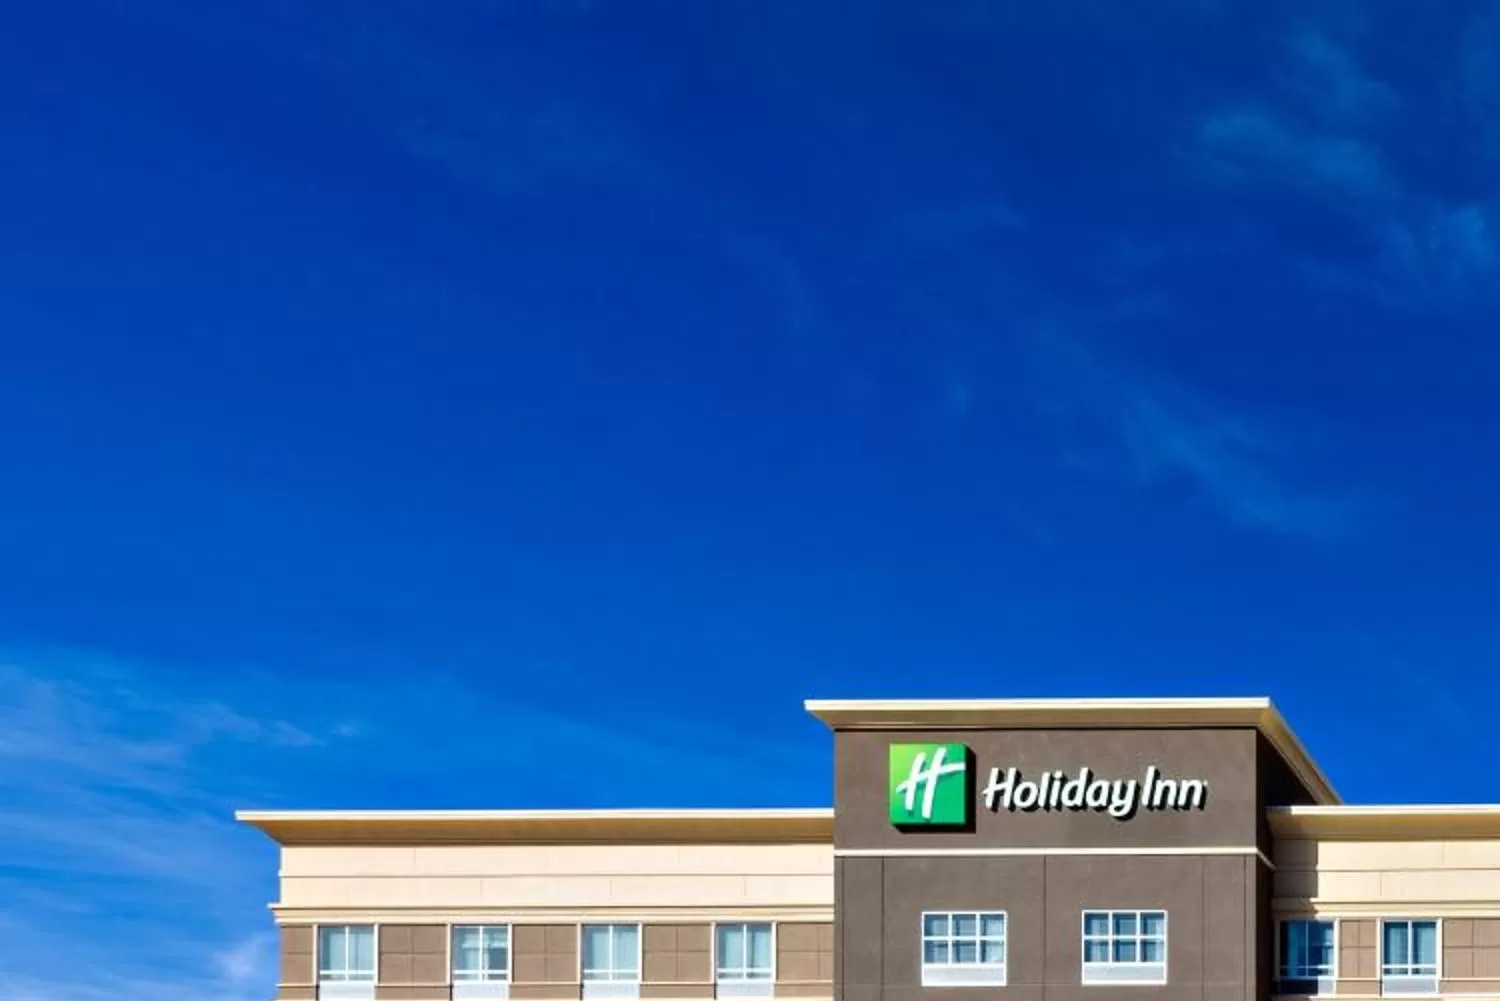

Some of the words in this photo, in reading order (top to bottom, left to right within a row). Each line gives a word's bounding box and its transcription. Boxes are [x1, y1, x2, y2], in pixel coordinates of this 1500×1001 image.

[897, 748, 965, 818] H
[982, 767, 1135, 818] Holiday
[1141, 766, 1204, 808] Inn
